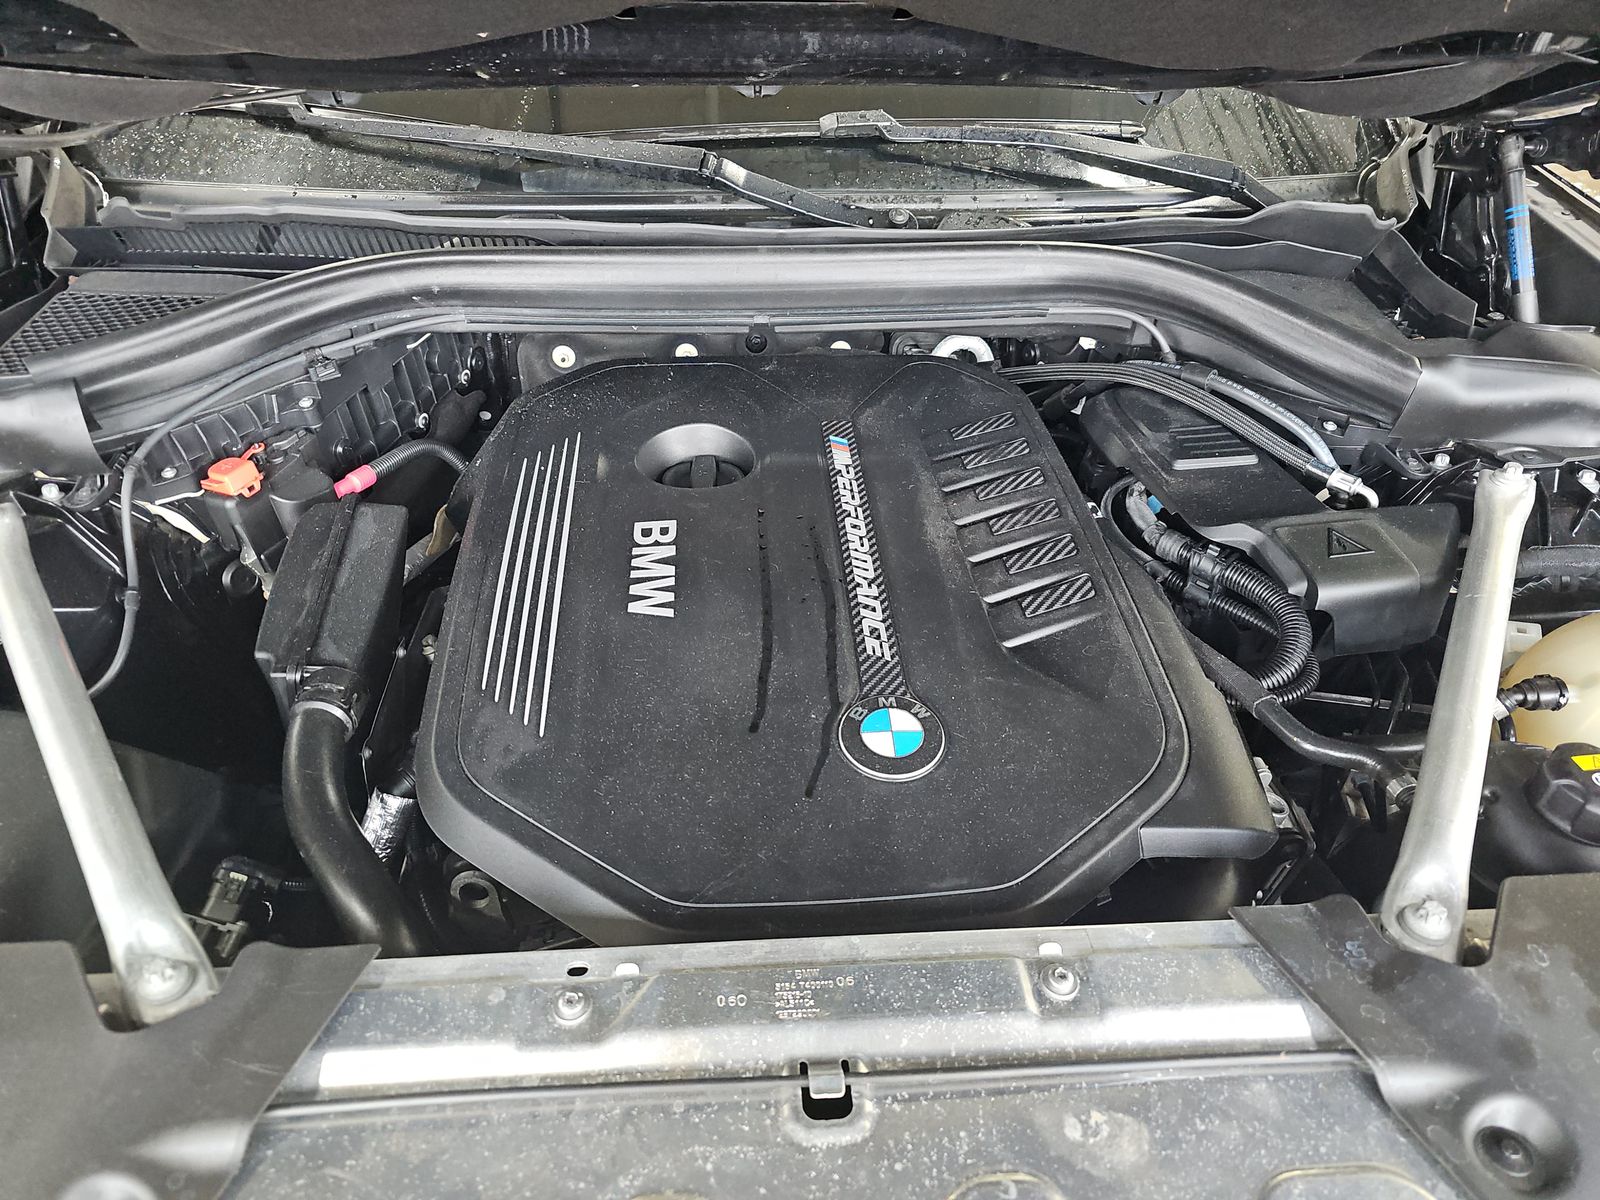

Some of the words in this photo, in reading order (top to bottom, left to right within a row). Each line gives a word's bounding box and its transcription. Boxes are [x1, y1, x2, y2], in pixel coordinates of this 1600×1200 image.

[627, 519, 677, 618] BMW
[835, 464, 892, 661] PERFORMANCE
[849, 696, 931, 721] BMW
